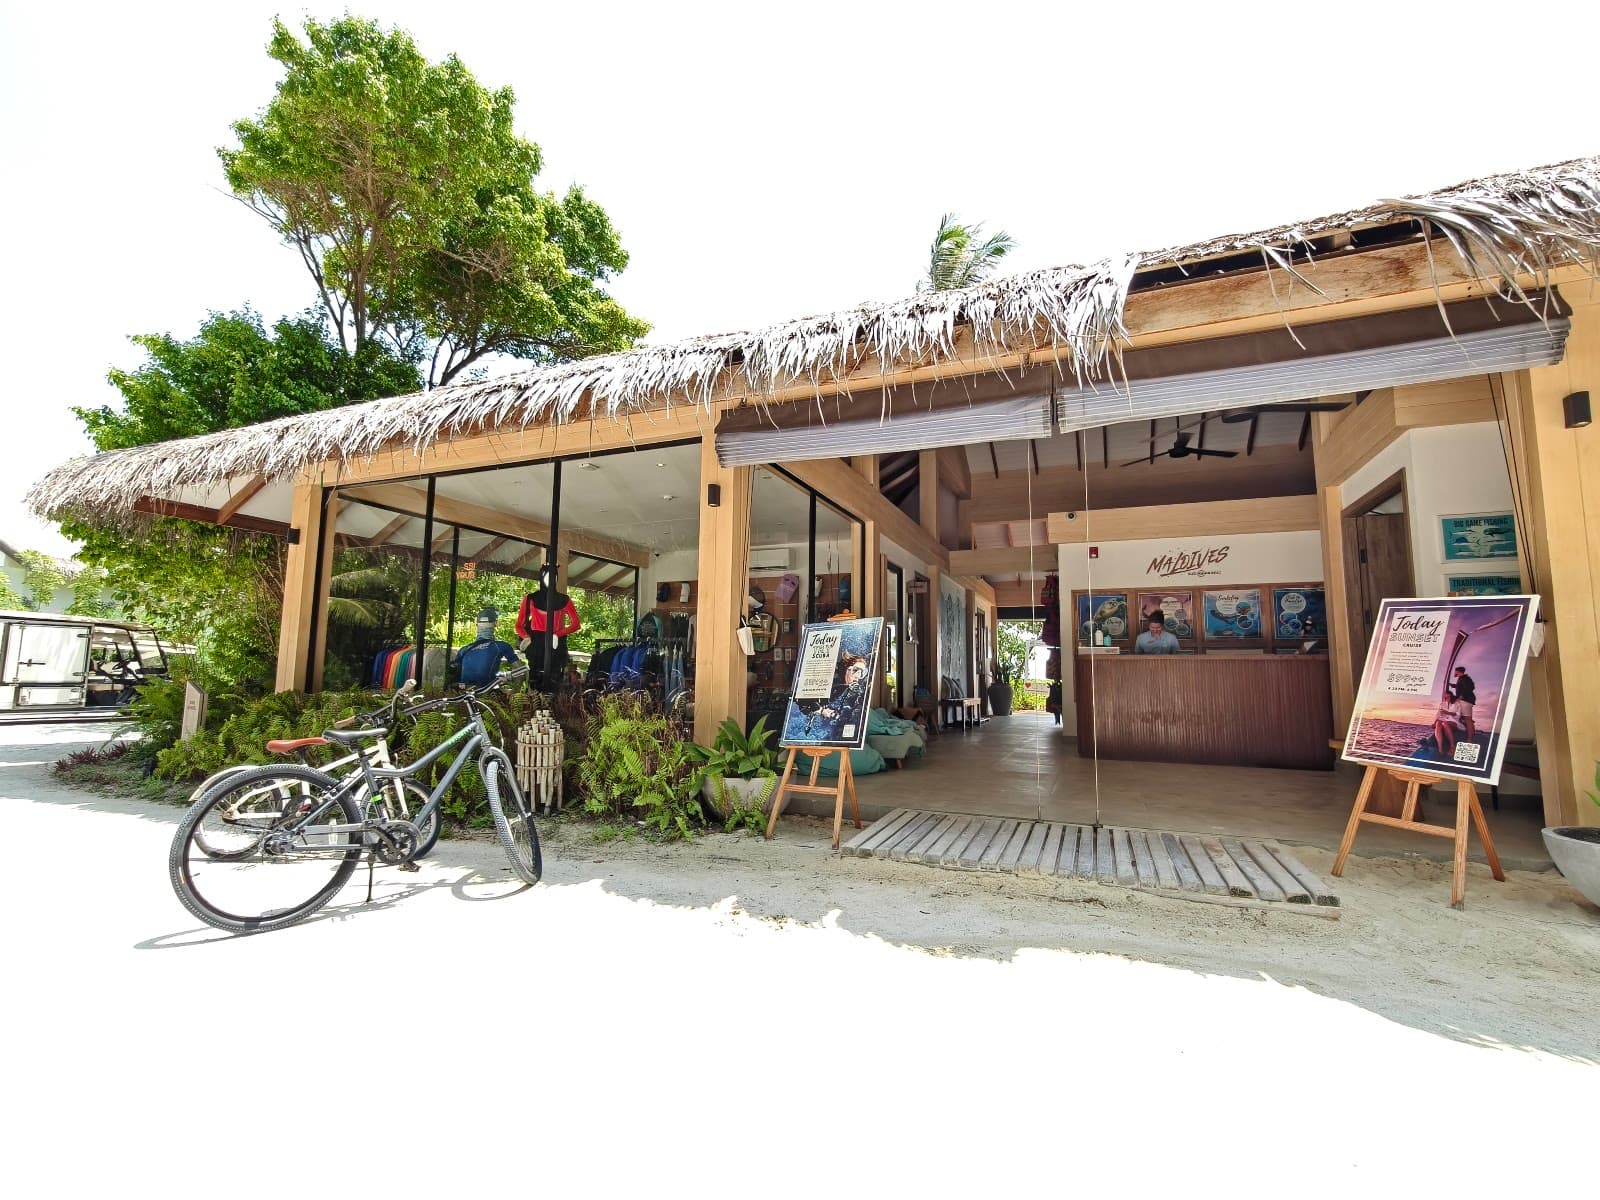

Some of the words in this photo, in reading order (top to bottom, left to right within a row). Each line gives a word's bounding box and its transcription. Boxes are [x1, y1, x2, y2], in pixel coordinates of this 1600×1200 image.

[1146, 545, 1230, 577] MALDIVES
[1393, 616, 1445, 636] Today
[810, 633, 838, 648] Today
[1389, 632, 1440, 643] SUNSET
